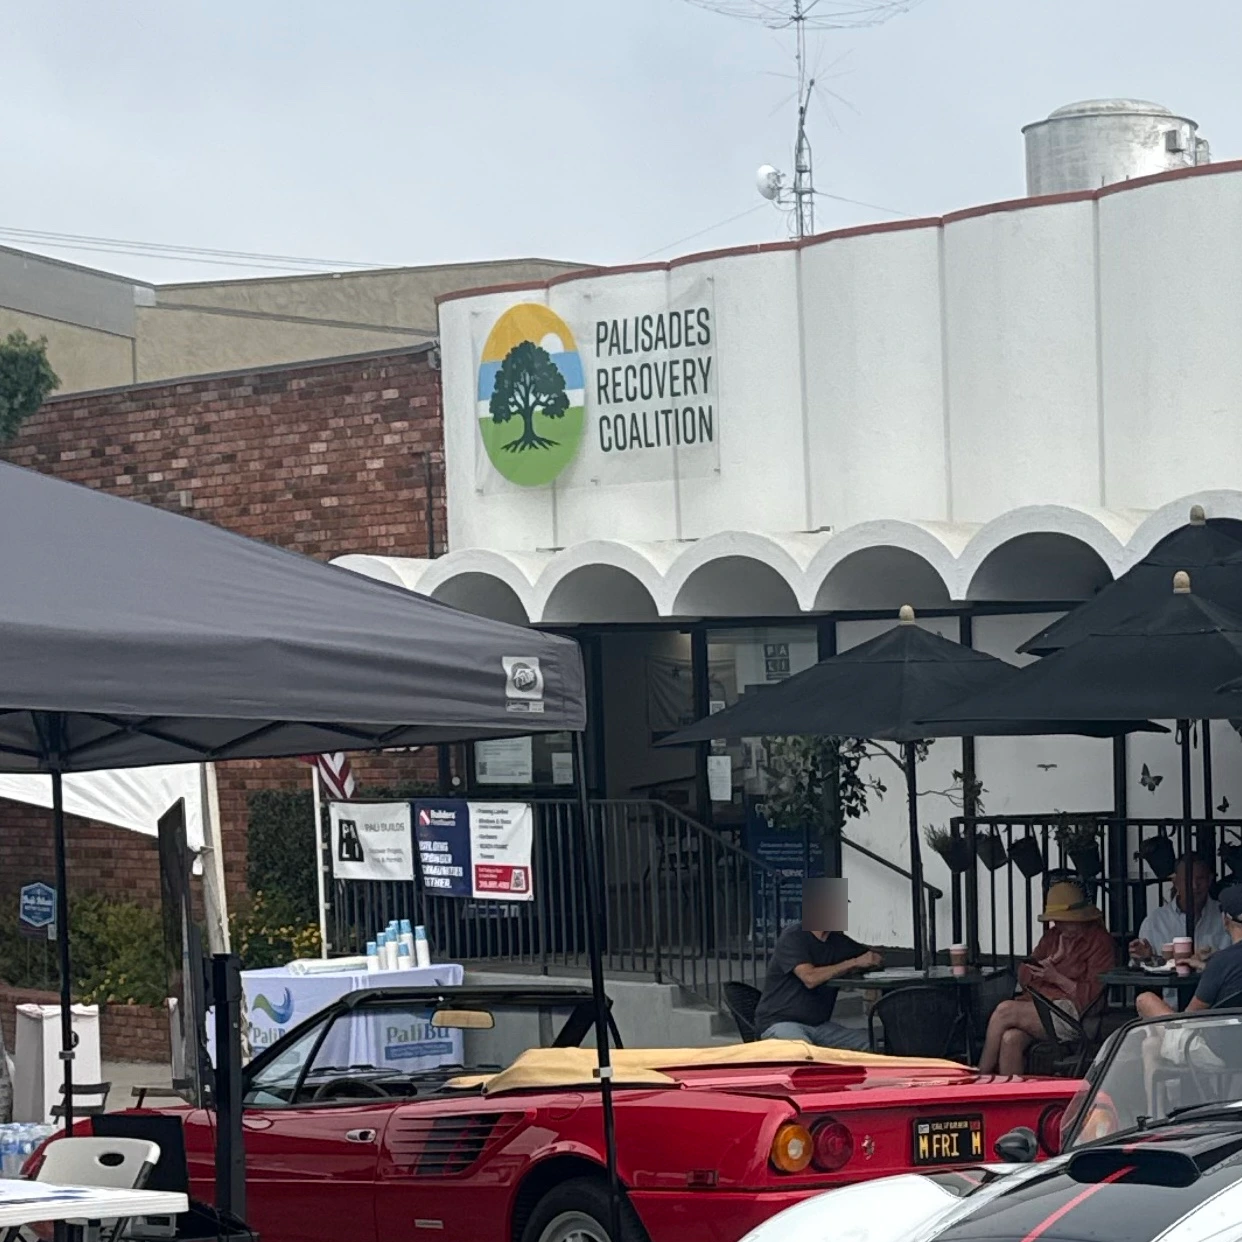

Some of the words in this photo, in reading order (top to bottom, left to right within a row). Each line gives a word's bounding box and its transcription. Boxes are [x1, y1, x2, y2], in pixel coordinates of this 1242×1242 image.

[596, 307, 711, 358] PALISADES
[597, 356, 712, 406] RECOVERY
[600, 405, 713, 453] COALITION
